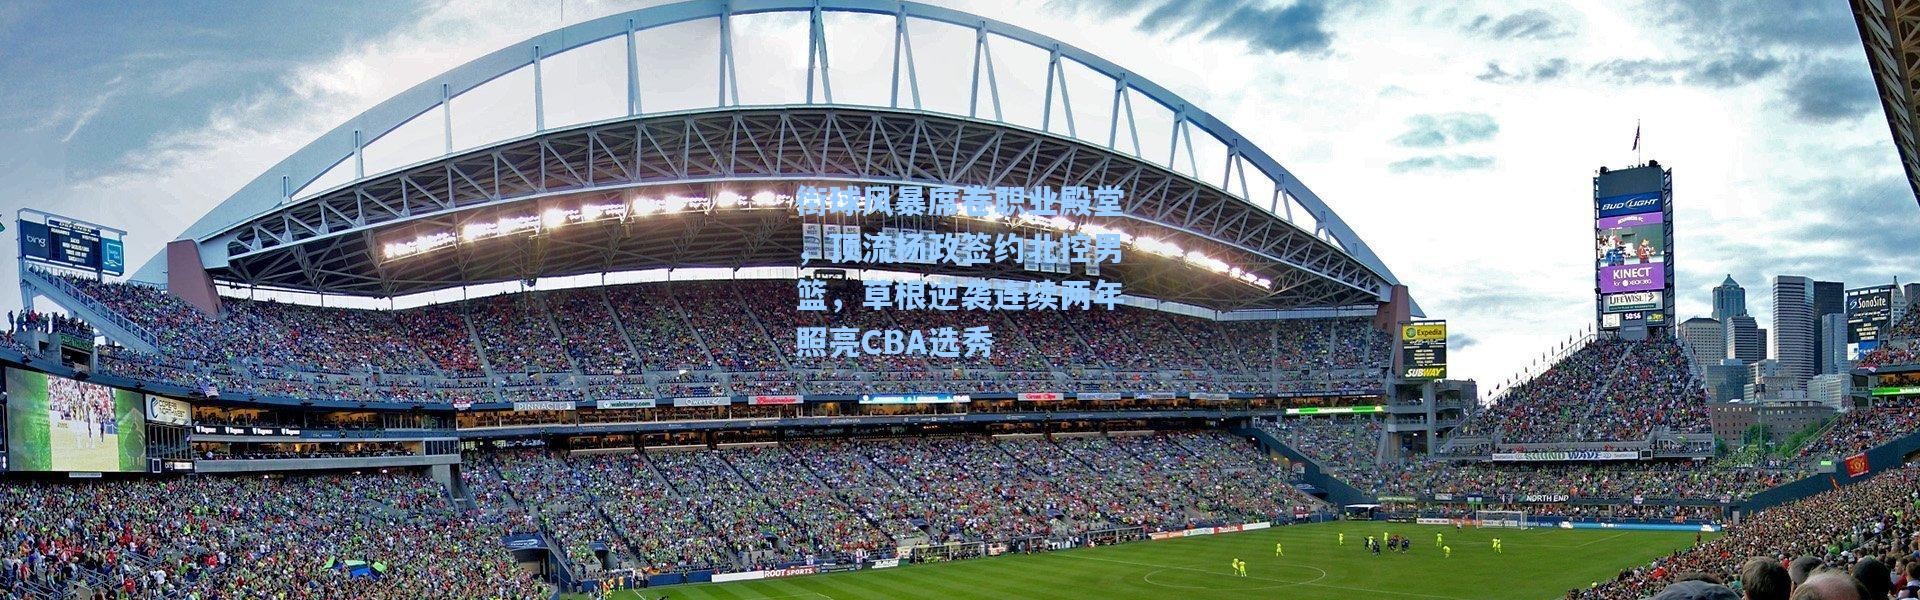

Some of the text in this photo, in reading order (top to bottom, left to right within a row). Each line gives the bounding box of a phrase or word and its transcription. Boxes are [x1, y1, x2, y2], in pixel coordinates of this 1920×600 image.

[1602, 198, 1658, 210] BUD LIGHT
[26, 234, 46, 247] bing
[1612, 267, 1652, 279] KINECT
[1857, 295, 1887, 309] SonoSite
[1416, 328, 1442, 337] Expedia
[1405, 368, 1445, 378] SUBWAY
[518, 402, 565, 410] PINNACLE
[1526, 494, 1569, 502] NORTH END
[764, 569, 787, 578] ROOT
